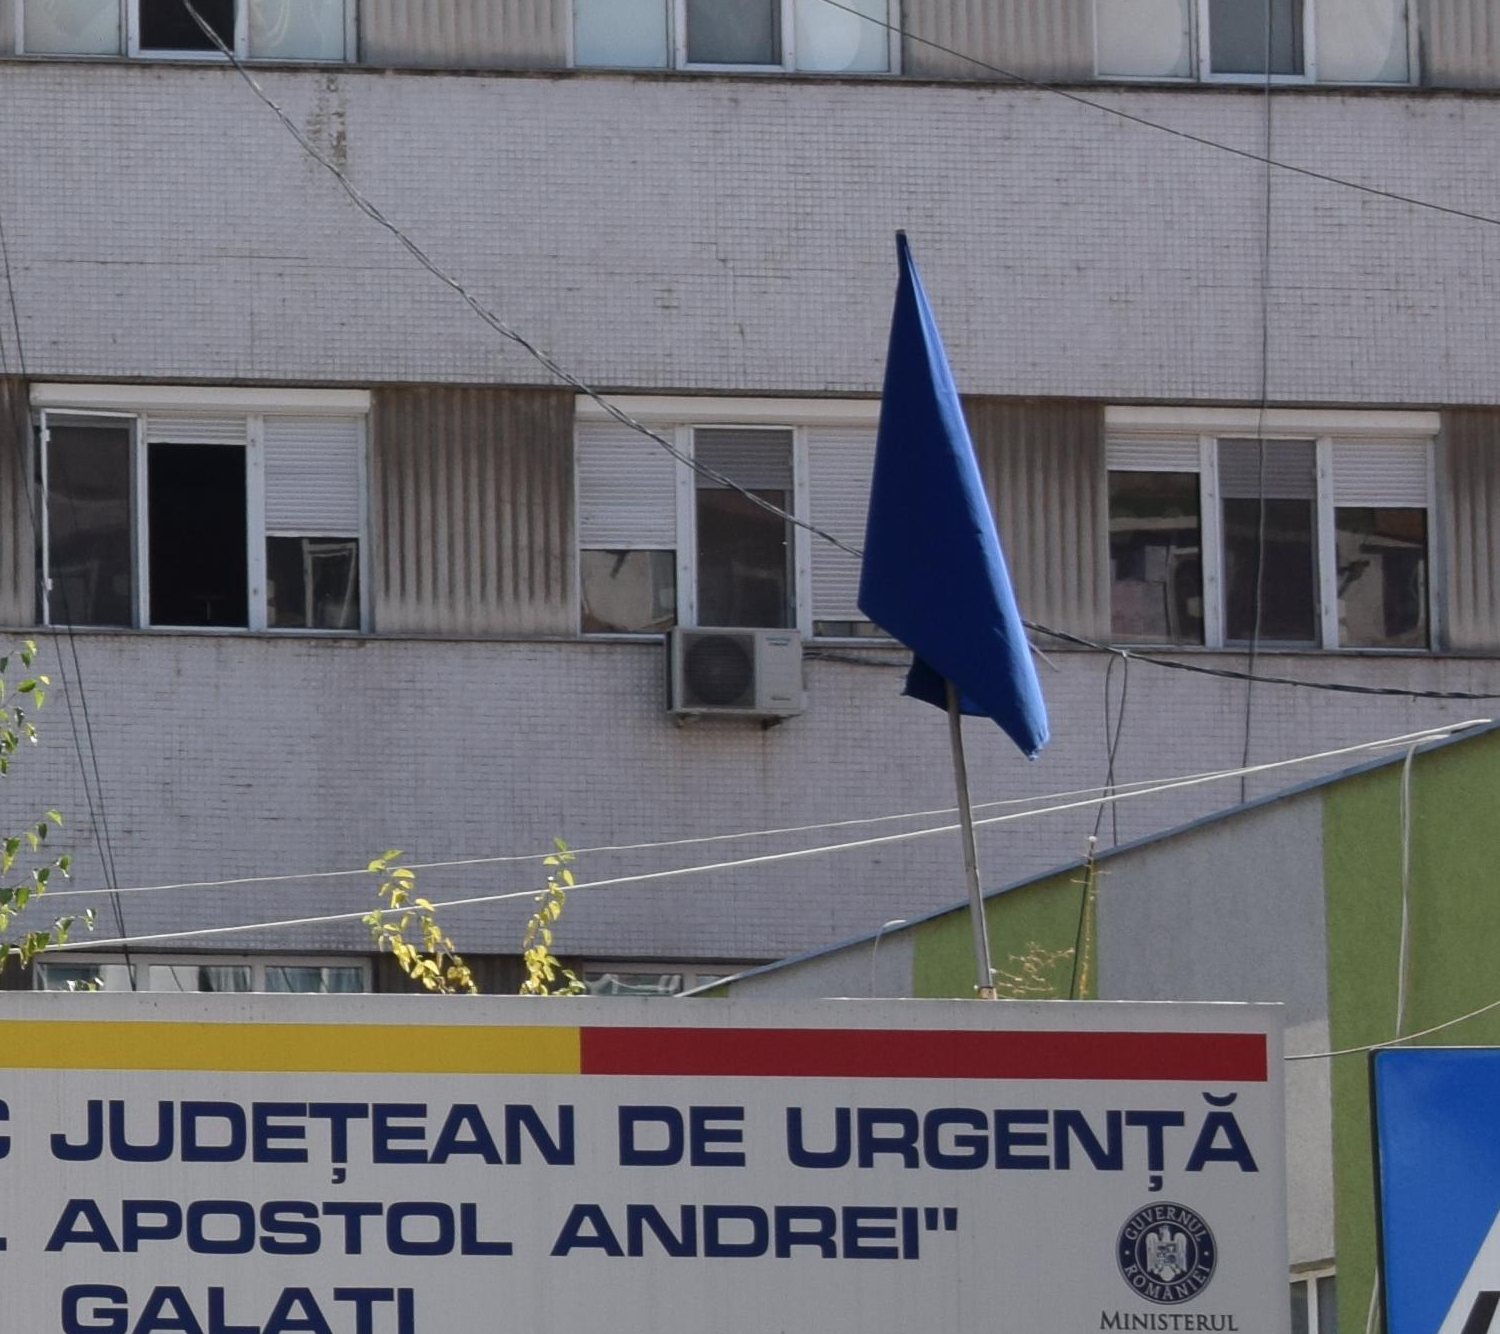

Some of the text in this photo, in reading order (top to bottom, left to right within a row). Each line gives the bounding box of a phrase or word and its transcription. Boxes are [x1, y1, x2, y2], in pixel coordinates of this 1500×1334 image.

[50, 1099, 575, 1184] JUDEȚEAN
[618, 1105, 745, 1167] DE
[786, 1092, 1259, 1191] URGENȚĂ
[44, 1199, 513, 1256] APOSTOL
[550, 1204, 958, 1260] ANDREI"
[1124, 1206, 1208, 1243] GUVERNUL
